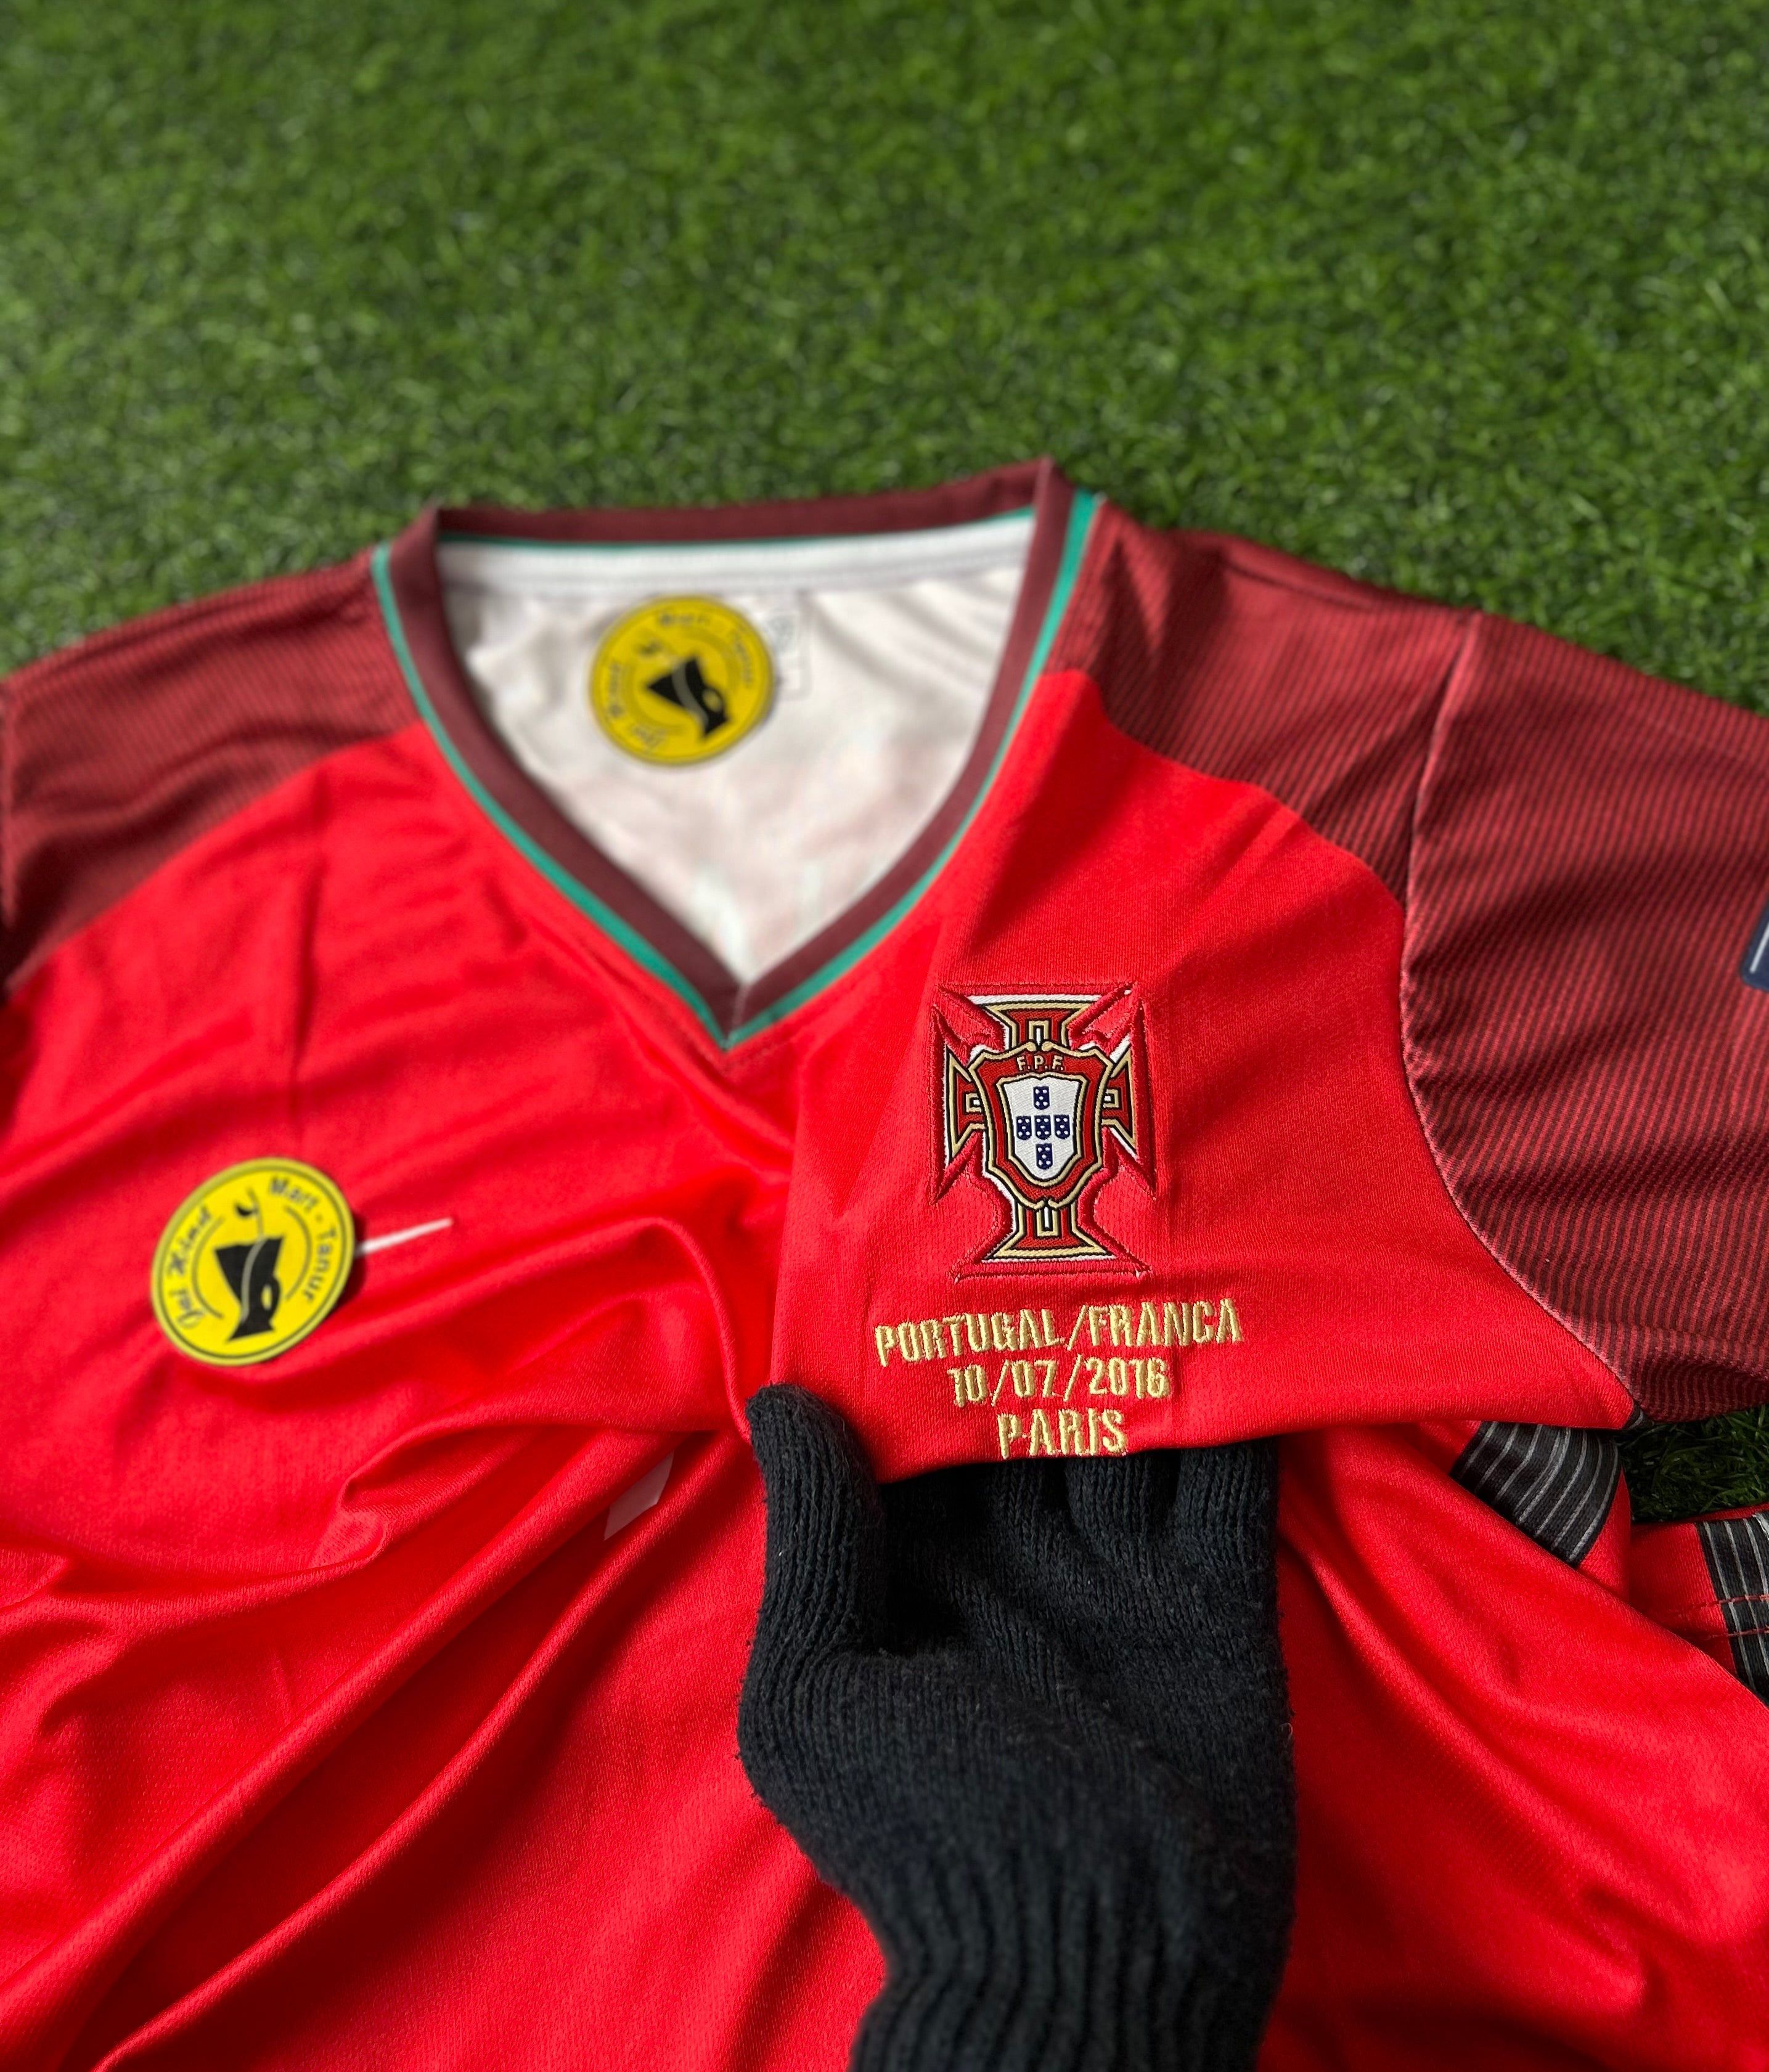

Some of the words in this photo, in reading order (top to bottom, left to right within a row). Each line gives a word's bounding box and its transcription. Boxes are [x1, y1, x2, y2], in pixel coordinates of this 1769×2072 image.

[304, 1225, 338, 1304] Tanur
[947, 1355, 1169, 1408] 10/07/2016
[997, 1408, 1128, 1459] PARIS
